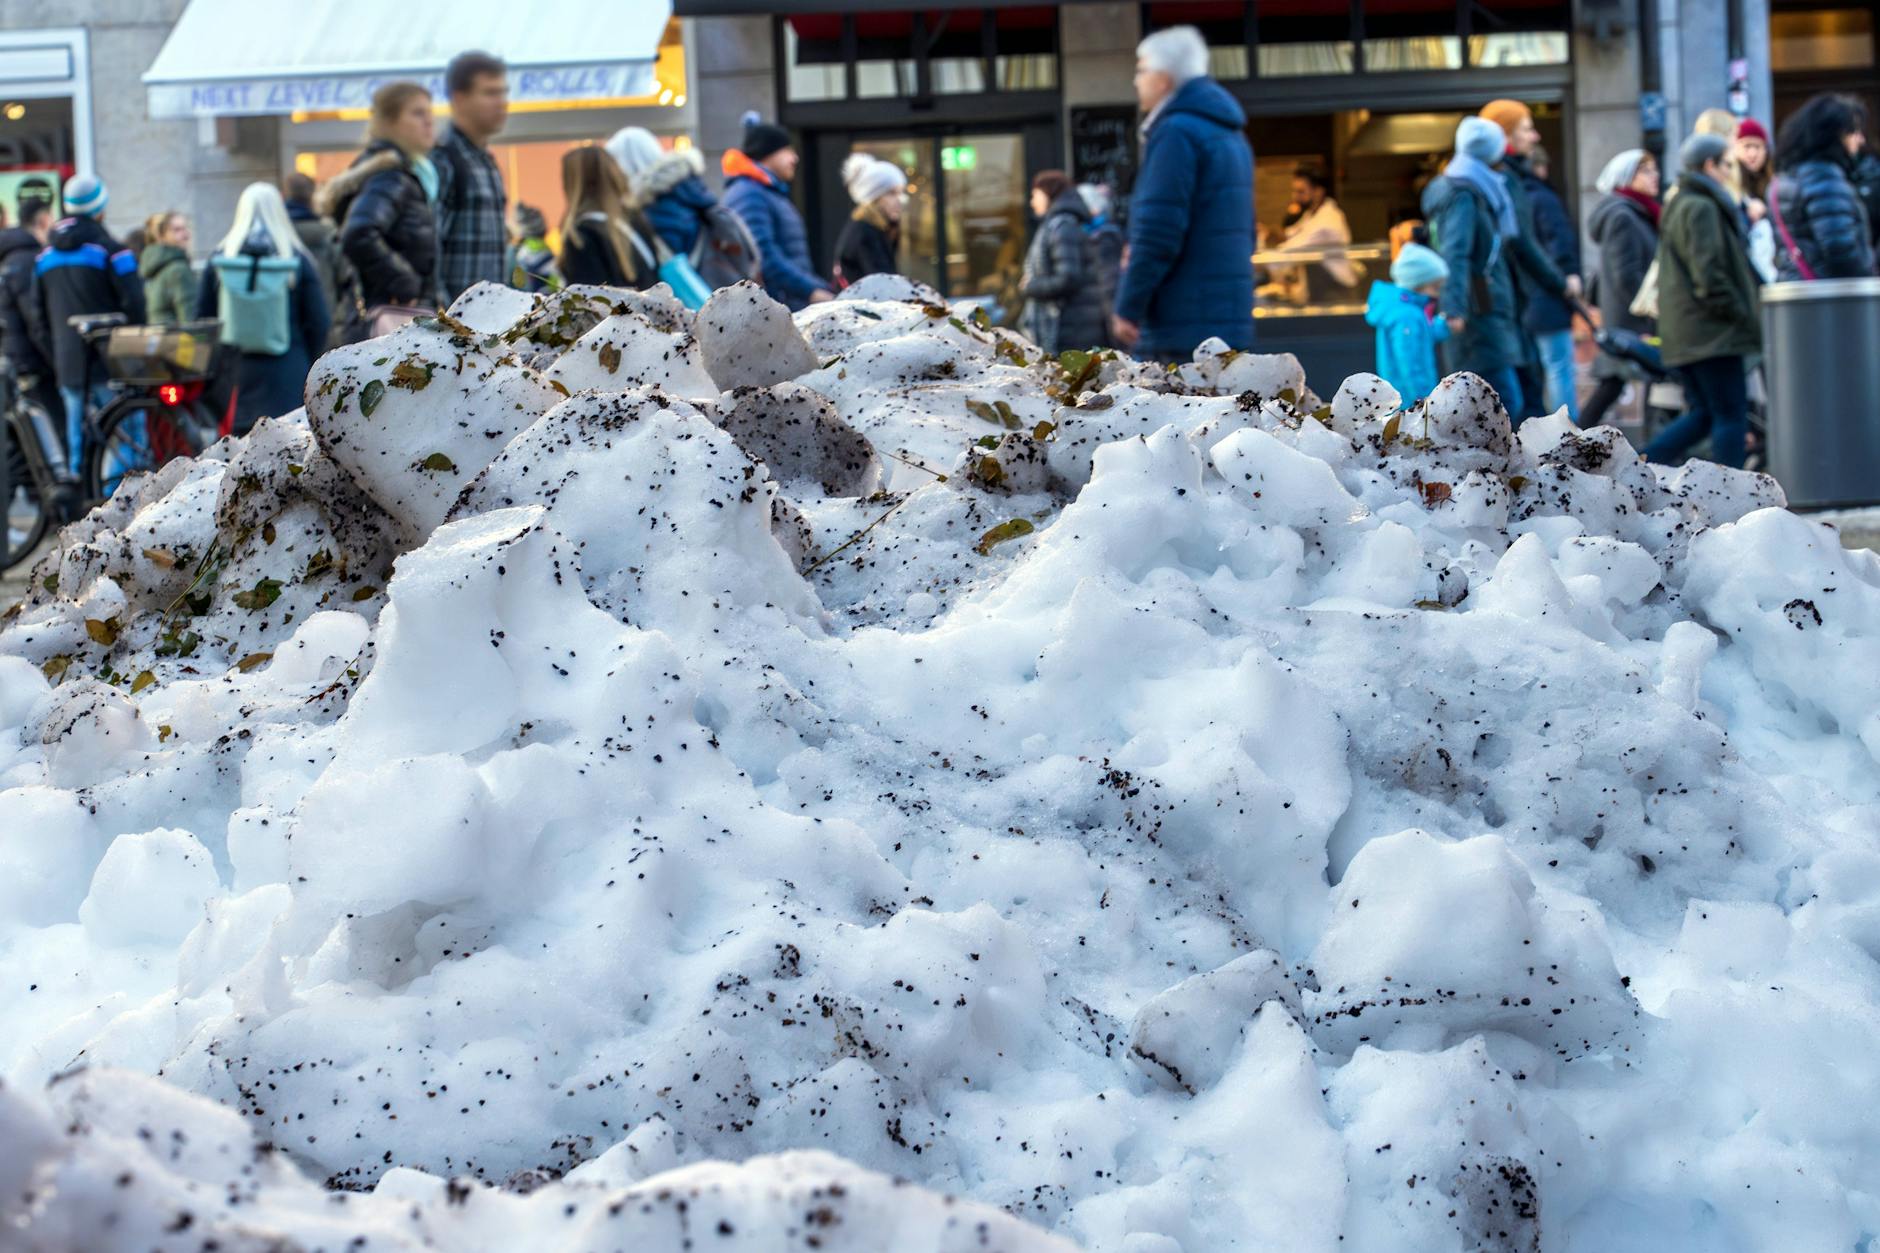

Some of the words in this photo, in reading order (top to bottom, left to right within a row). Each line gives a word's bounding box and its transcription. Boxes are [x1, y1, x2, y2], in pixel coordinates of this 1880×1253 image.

[191, 84, 252, 110] NEXT
[266, 78, 353, 107] LEVEL
[519, 68, 609, 95] ROLLS
